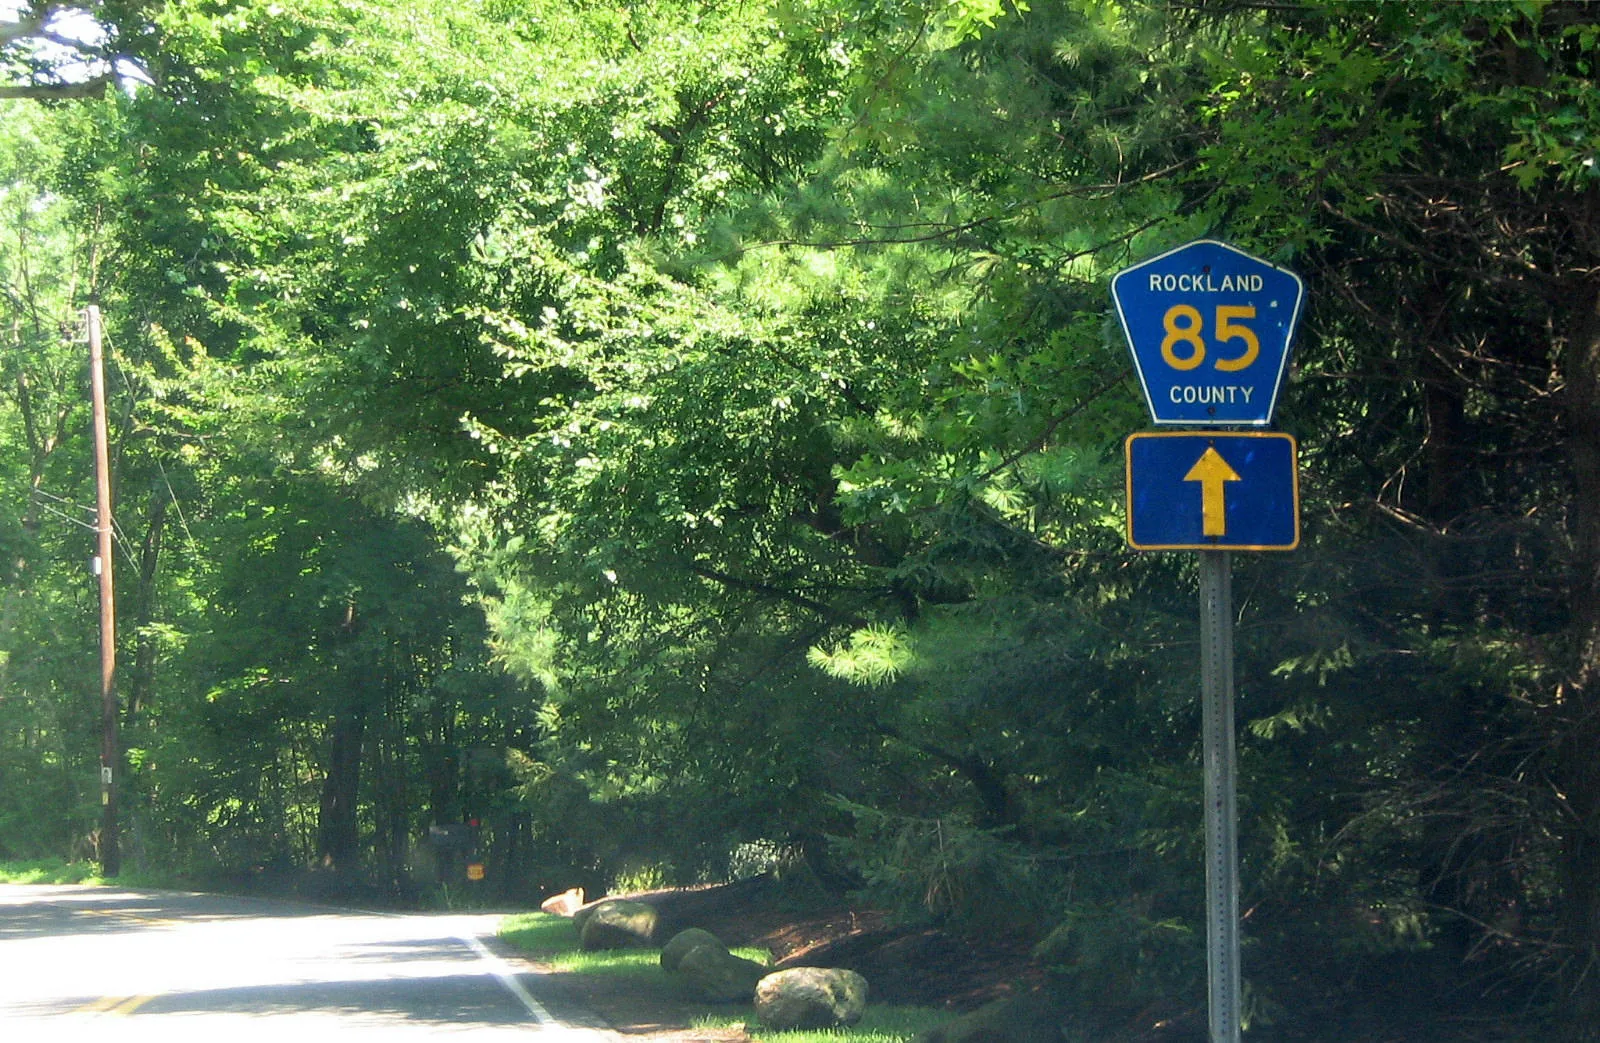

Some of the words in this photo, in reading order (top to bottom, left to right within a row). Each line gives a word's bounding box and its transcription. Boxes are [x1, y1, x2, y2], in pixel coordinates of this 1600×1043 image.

[1149, 274, 1263, 292] ROCKLAND
[1161, 304, 1260, 372] 85
[1170, 385, 1254, 404] COUNTY
